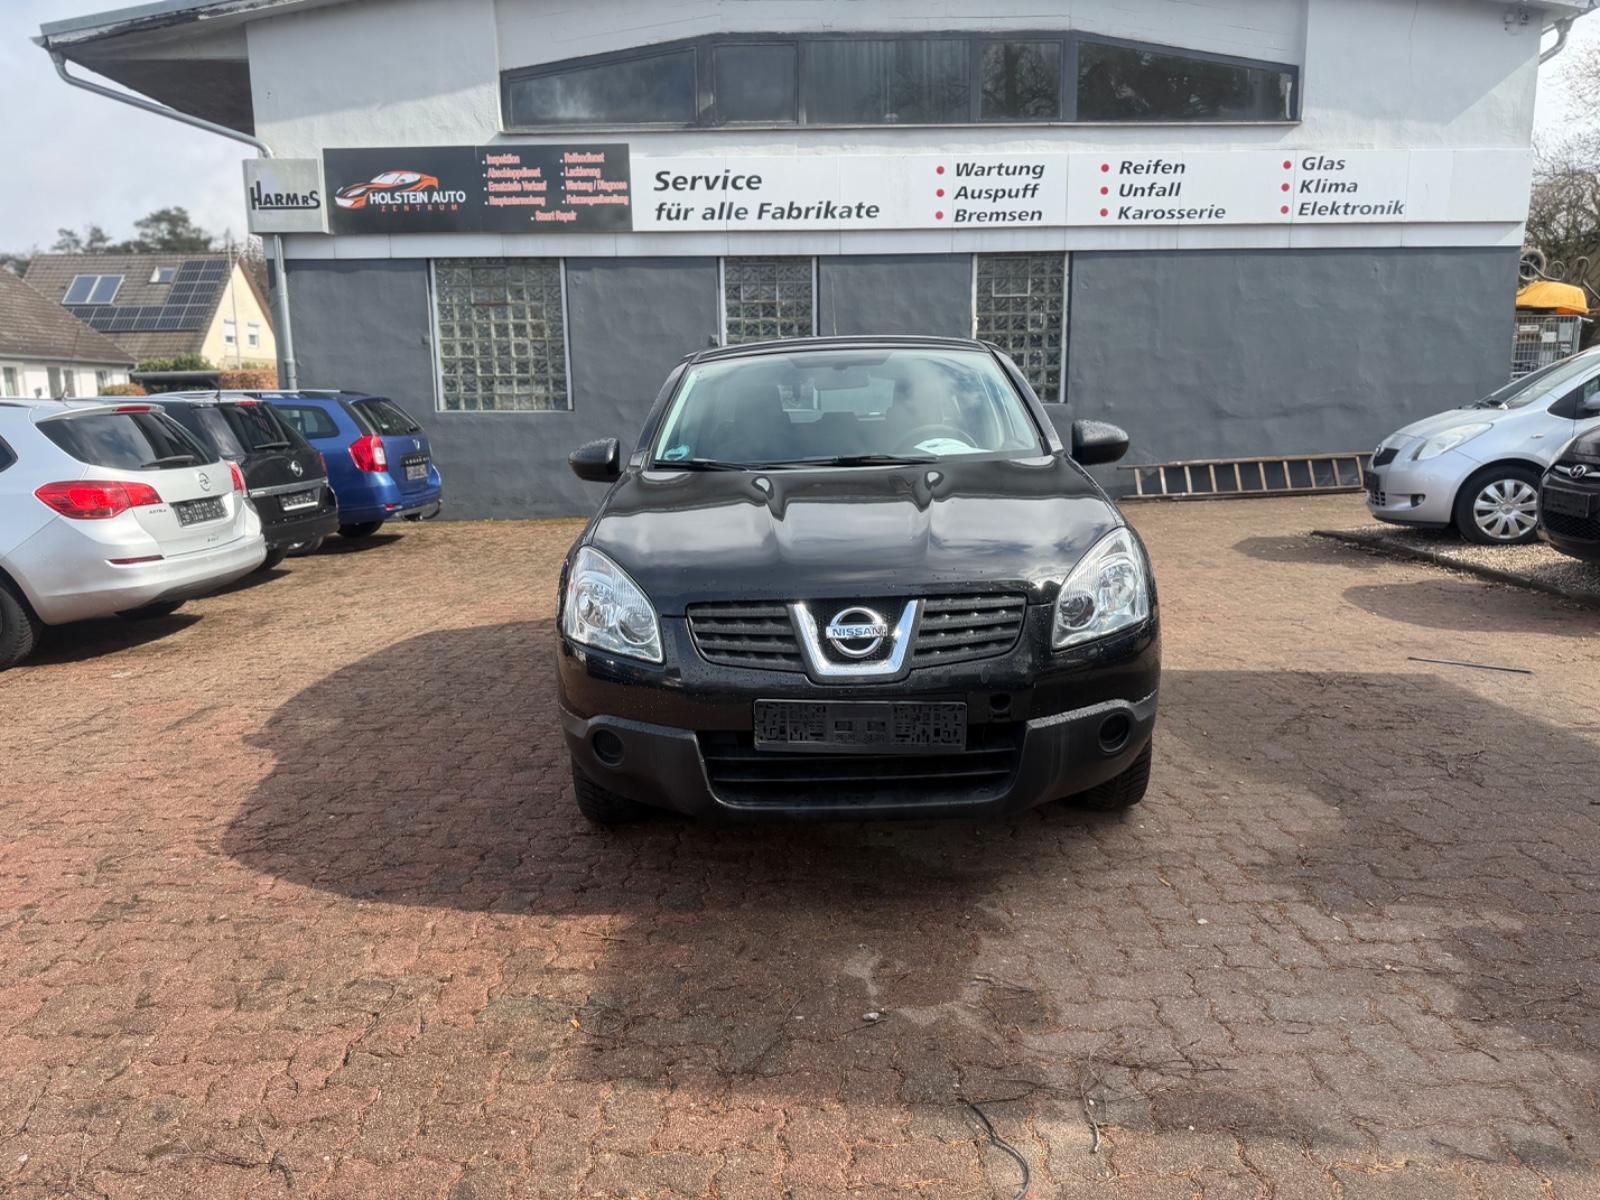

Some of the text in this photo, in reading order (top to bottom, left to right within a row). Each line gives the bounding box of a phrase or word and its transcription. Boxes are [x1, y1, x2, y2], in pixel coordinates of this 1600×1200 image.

[954, 162, 1046, 179] Wartung
[1118, 159, 1186, 175] Reifen
[1300, 156, 1346, 171] Glas
[653, 169, 763, 192] Service
[1298, 179, 1359, 195] Klima
[369, 190, 466, 204] HOLSTEIN AUTO
[954, 183, 1041, 201] Auspuff
[1118, 181, 1183, 198] Unfall
[381, 204, 460, 212] ZENTRUM
[654, 200, 880, 222] für alle Fabrikate
[953, 207, 1044, 224] Bremsen
[1117, 204, 1227, 220] Karosserie
[1297, 200, 1405, 217] Elektronik
[831, 626, 881, 637] NISSAN
